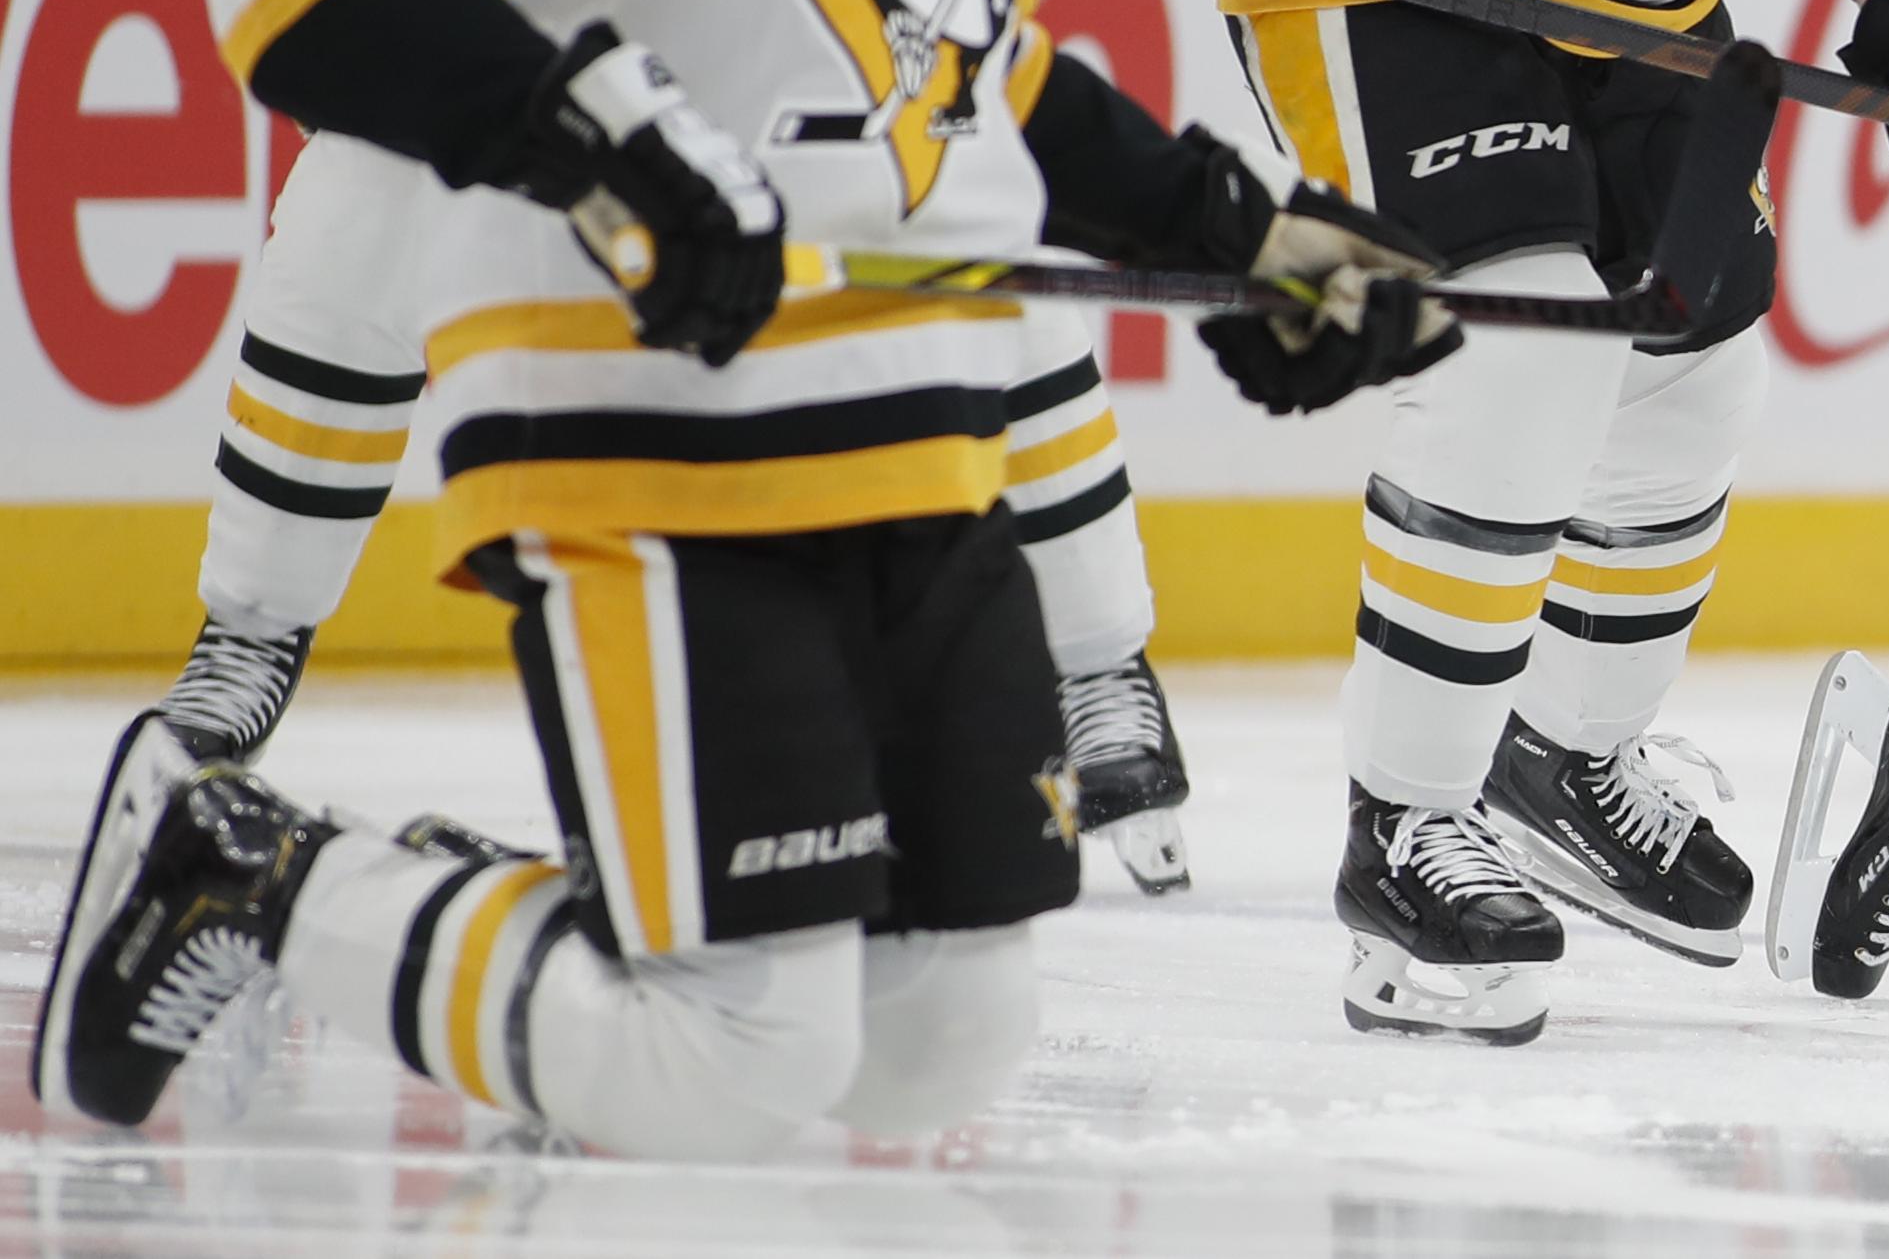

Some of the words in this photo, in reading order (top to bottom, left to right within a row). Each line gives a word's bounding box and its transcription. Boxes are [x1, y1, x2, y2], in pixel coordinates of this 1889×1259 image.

[1406, 122, 1571, 179] CCM
[1554, 818, 1619, 878] BAUER
[1375, 877, 1419, 924] BAUER
